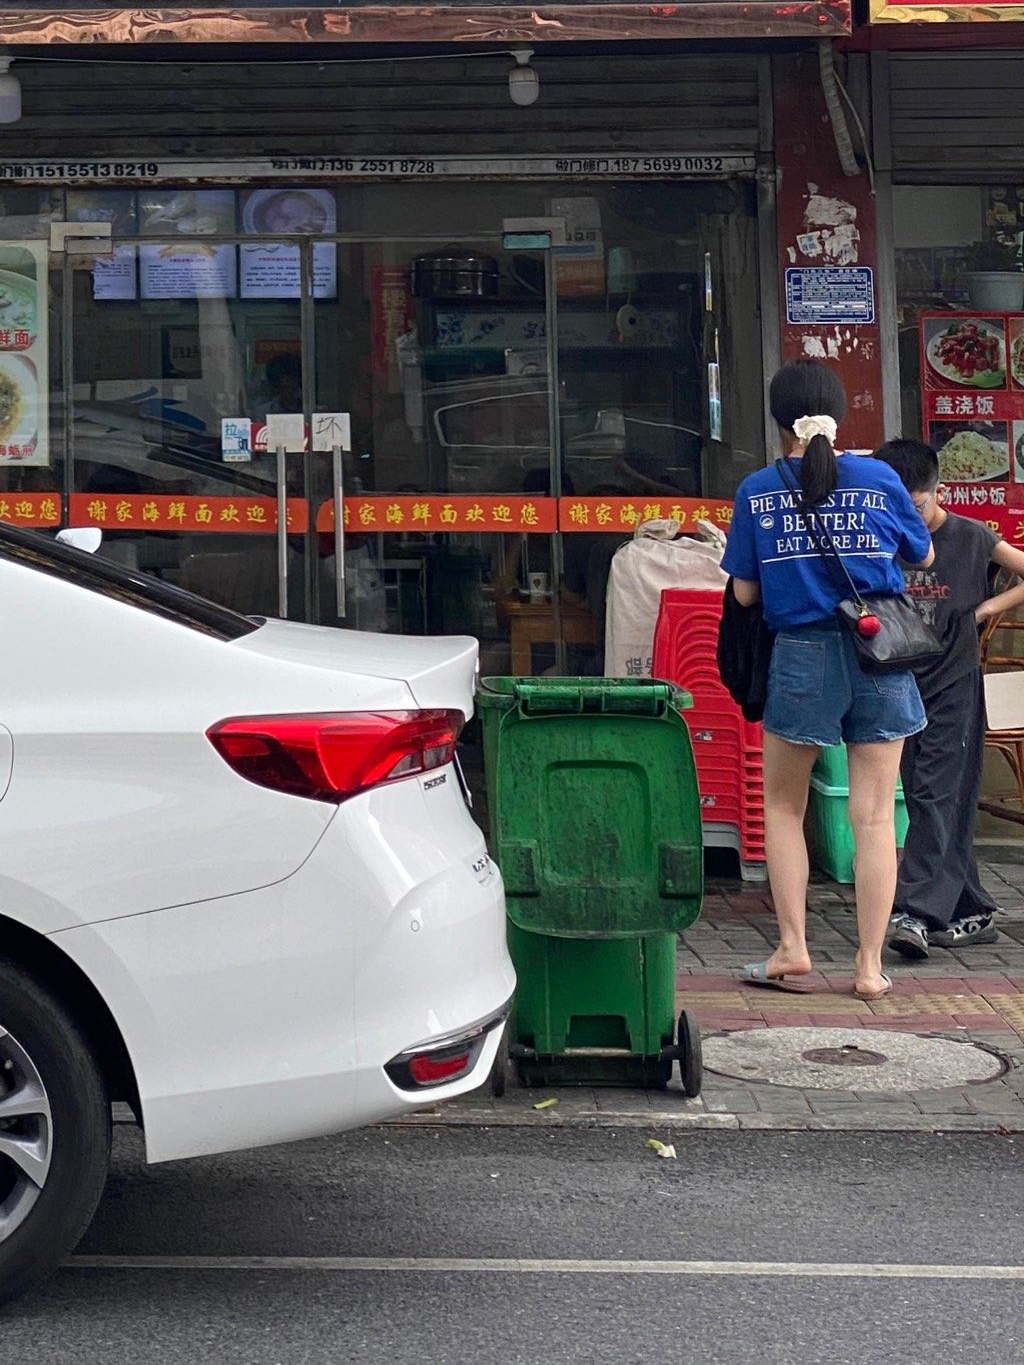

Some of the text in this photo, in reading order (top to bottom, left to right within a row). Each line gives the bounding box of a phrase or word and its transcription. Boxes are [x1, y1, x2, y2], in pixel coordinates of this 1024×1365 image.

[935, 395, 995, 415] 盖浇饭
[750, 496, 775, 514] PIE
[841, 493, 860, 508] IT
[861, 493, 889, 511] ALL
[782, 512, 866, 533] BETTER!
[777, 537, 803, 554] EAT
[856, 534, 880, 549] PIE
